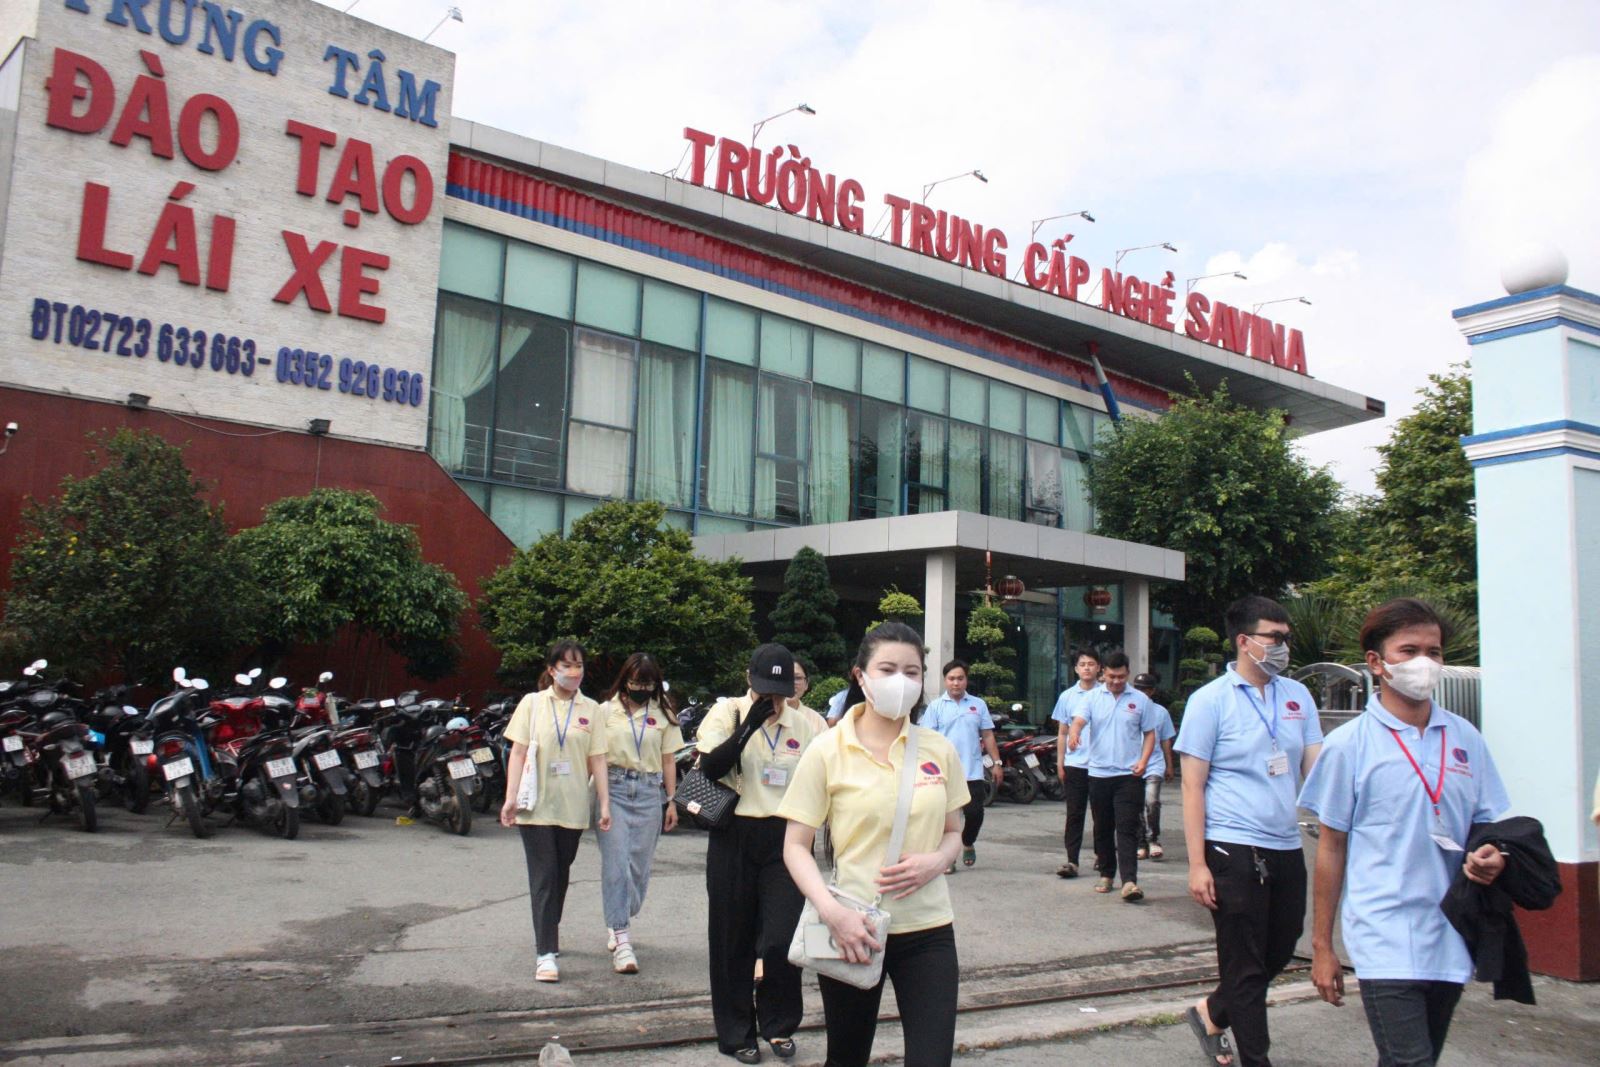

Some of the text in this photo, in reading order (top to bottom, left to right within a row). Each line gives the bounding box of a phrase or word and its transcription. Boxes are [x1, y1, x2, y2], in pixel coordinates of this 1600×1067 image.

[65, 0, 440, 128] RUNG TÂM
[45, 47, 433, 227] ĐÀO TẠO
[76, 181, 390, 323] LÁI XE
[683, 127, 1308, 375] TRƯỜNG TRUNG CẤP NGHỀ SAVINA
[158, 323, 206, 369] 633
[277, 347, 332, 390] 0352
[339, 358, 380, 398] 926
[383, 367, 423, 407] 936
